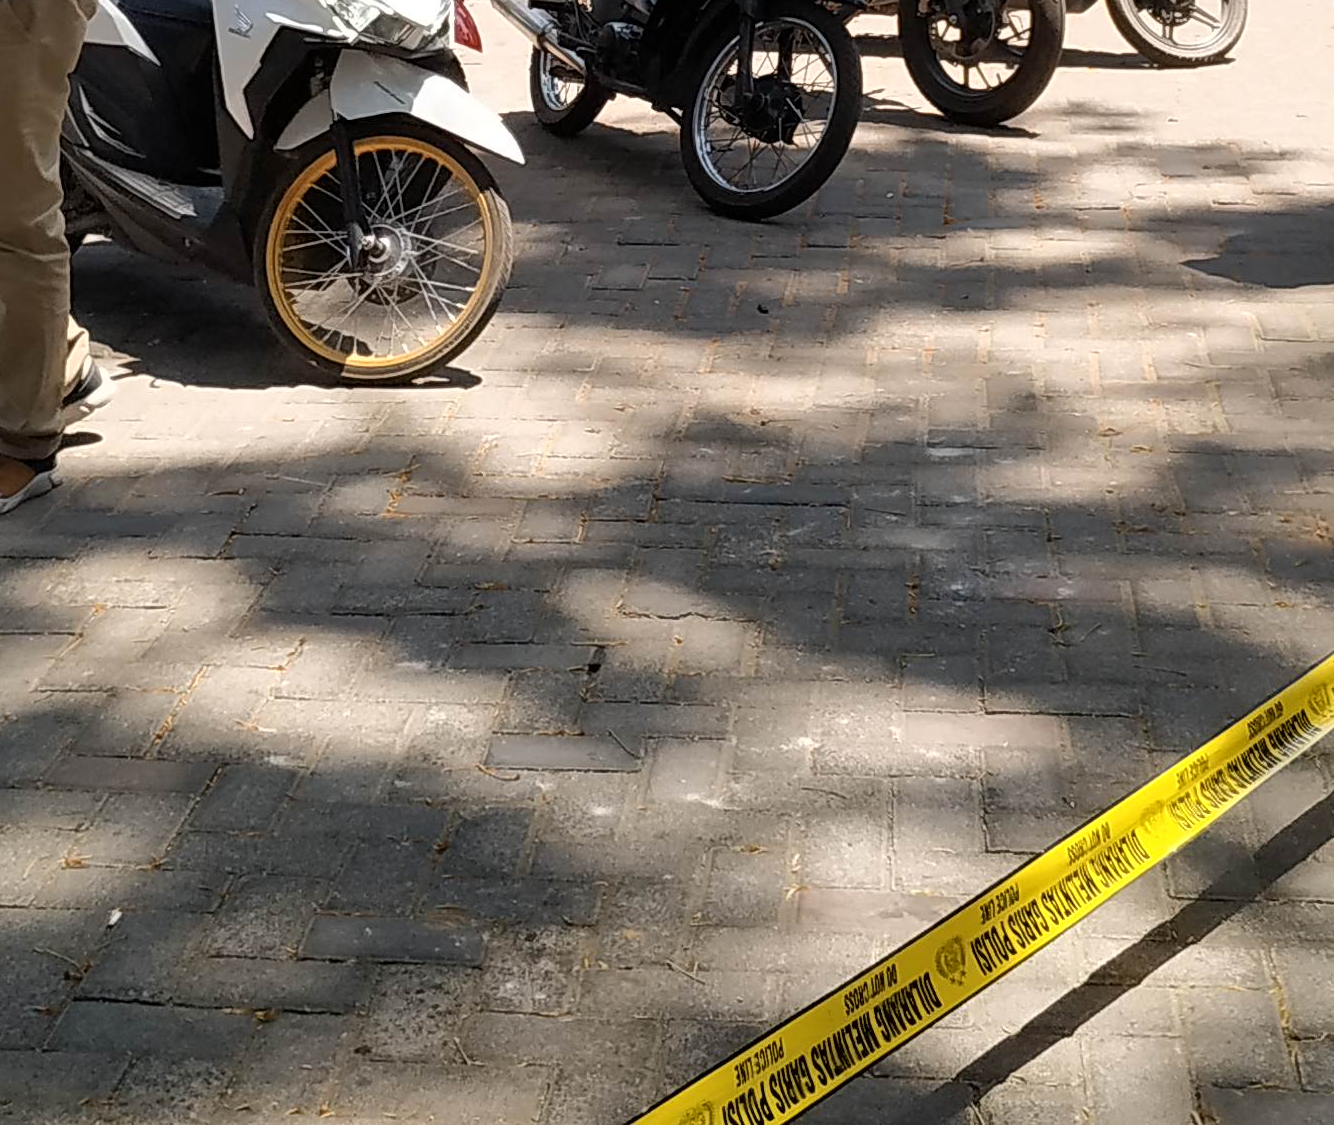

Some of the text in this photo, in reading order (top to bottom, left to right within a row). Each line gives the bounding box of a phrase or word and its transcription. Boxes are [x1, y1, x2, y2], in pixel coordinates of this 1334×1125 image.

[969, 829, 1150, 976] DILARANG MELINTAS GARIS POLISI
[843, 963, 898, 1016] DO NOT CROSS
[873, 971, 942, 1043] DILARANG
[734, 1036, 785, 1088] POLICE LINE
[810, 1011, 882, 1087] MELINTAS
[769, 1054, 816, 1115] GARIS
